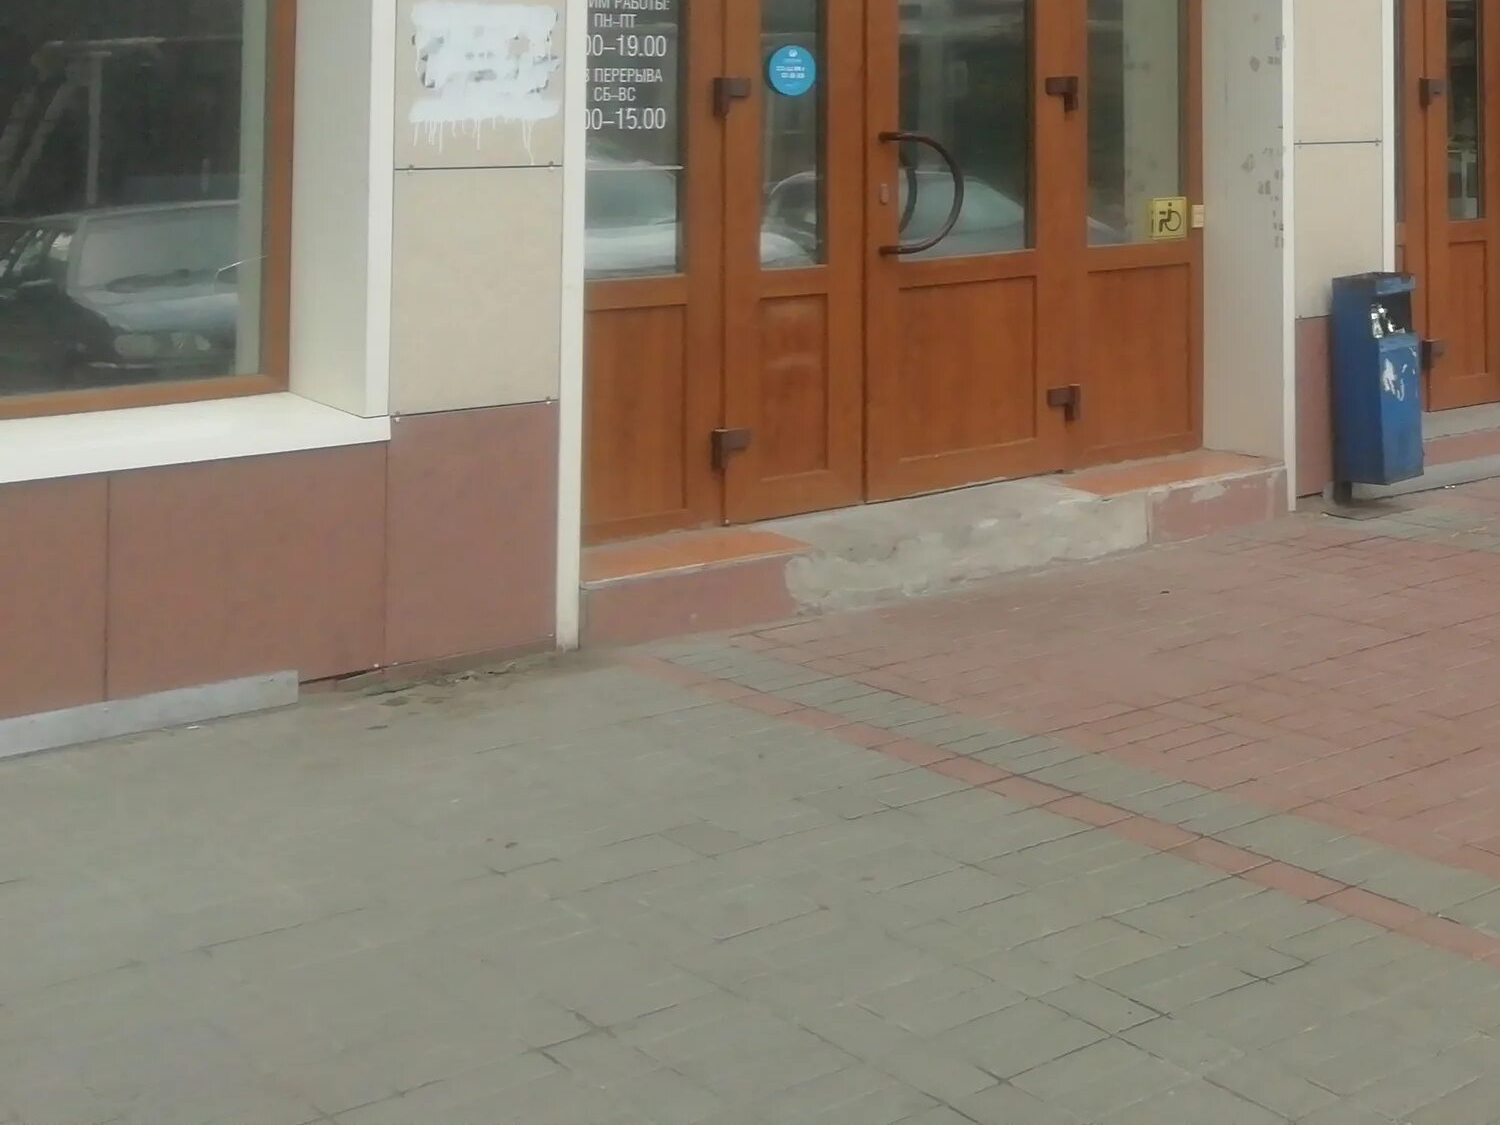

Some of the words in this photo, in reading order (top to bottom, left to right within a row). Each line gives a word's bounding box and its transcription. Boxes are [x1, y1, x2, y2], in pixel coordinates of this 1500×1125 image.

[593, 13, 637, 28] ПН-ПТ
[594, 68, 664, 83] ПЕРЕРЫВА
[593, 86, 636, 102] СБ-ВС
